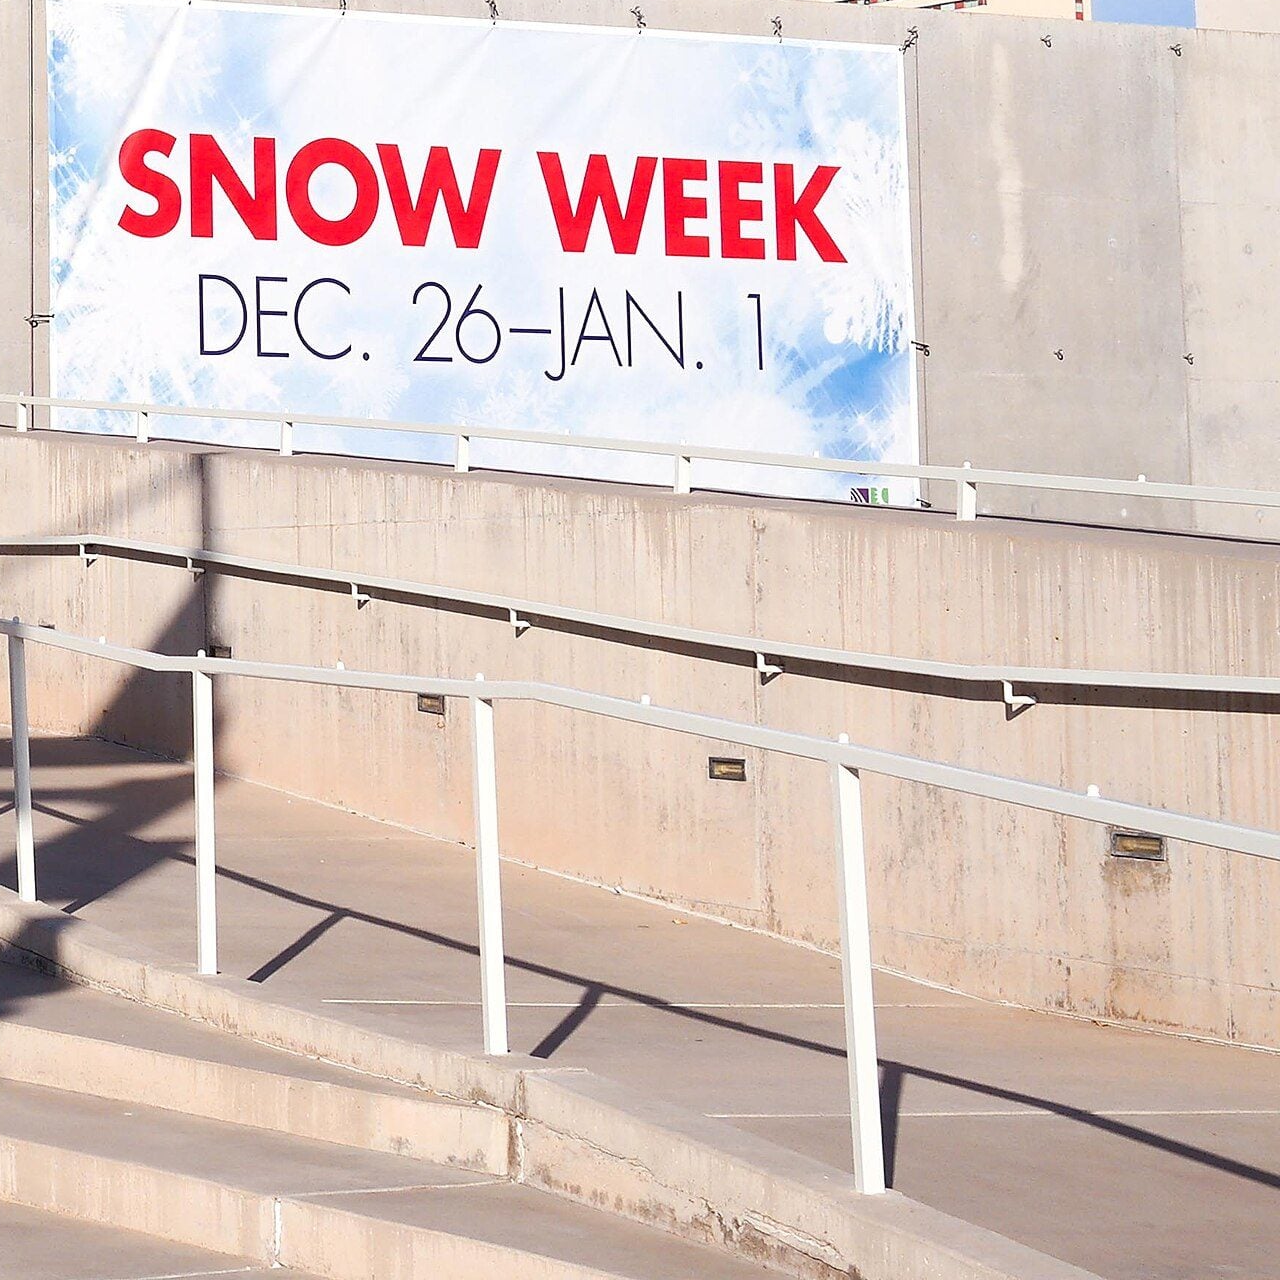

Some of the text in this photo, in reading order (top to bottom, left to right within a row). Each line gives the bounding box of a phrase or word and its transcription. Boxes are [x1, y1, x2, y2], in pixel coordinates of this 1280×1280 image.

[117, 128, 848, 264] SNOW WEEK
[198, 273, 370, 362] DEC.
[747, 293, 764, 371] 1
